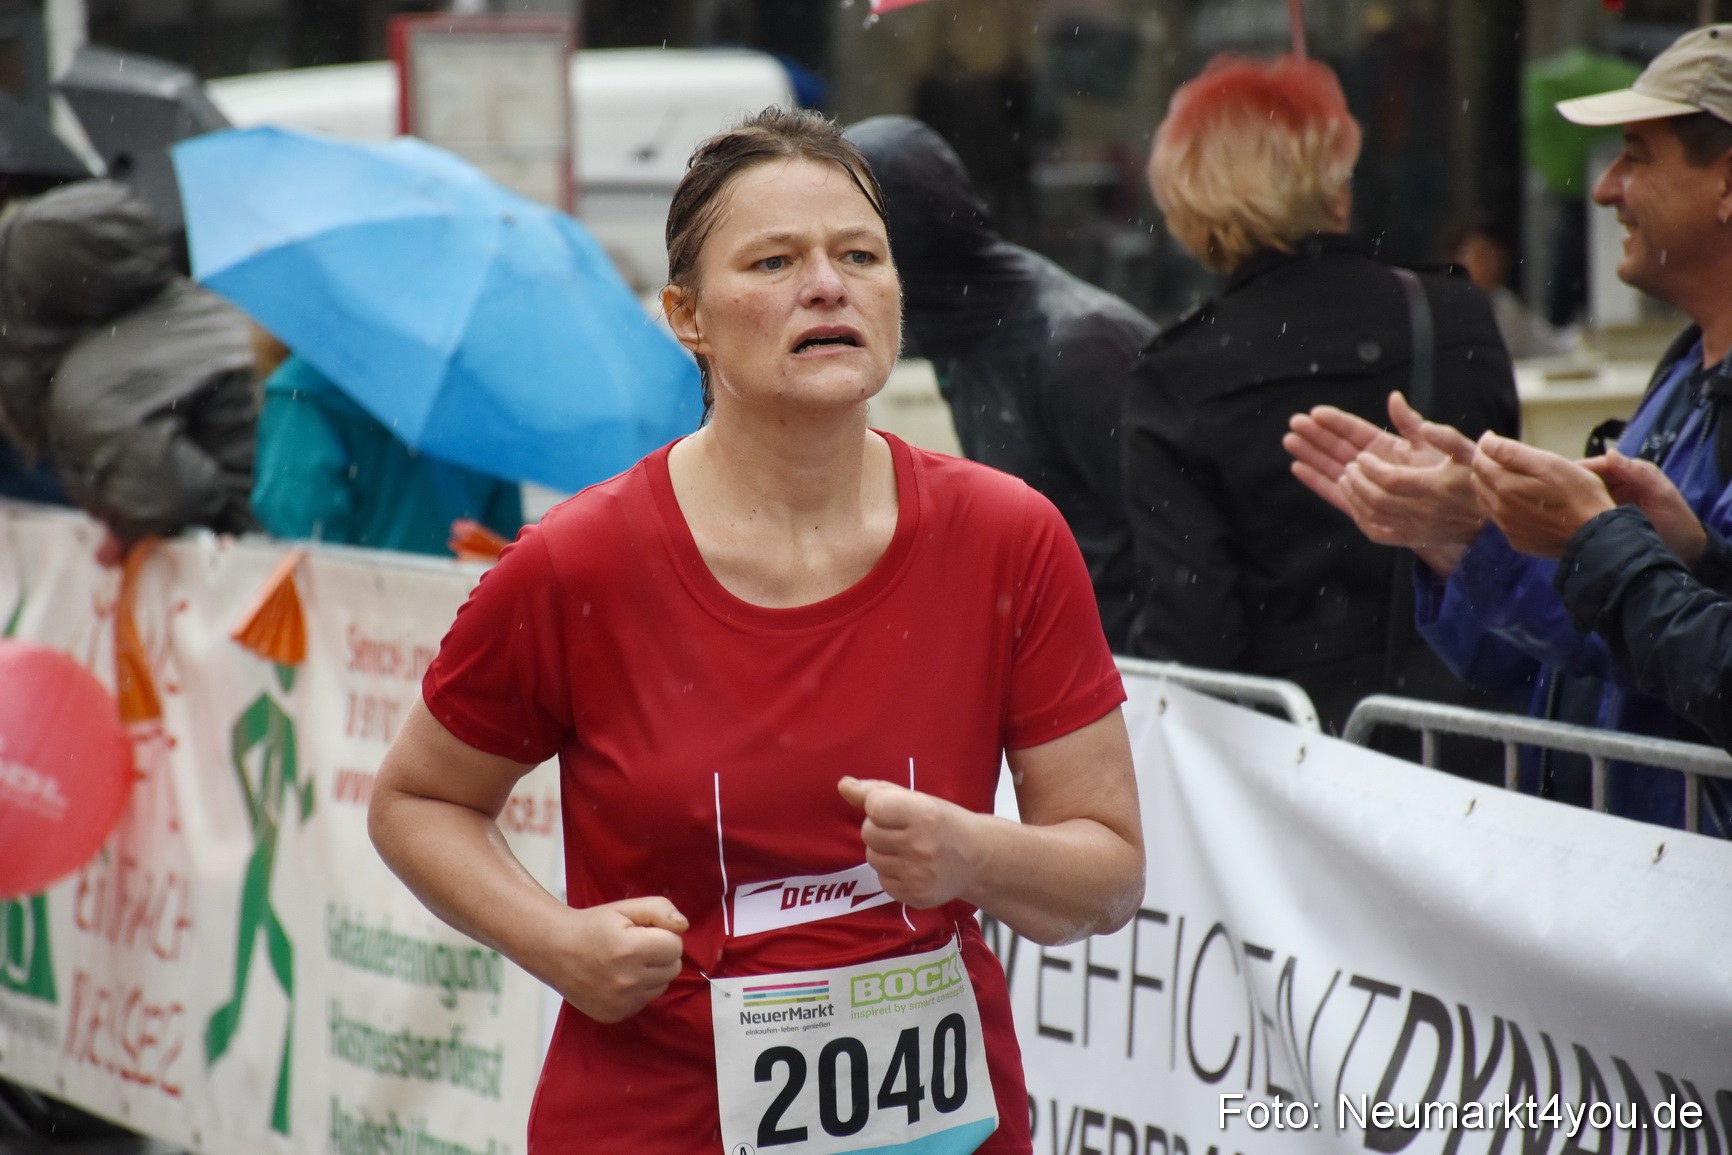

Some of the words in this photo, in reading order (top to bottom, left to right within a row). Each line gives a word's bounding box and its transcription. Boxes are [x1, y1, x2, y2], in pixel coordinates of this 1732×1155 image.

[780, 879, 858, 911] DEHN
[850, 953, 963, 1008] BOCK
[739, 1003, 834, 1025] NeuerMarkt
[851, 1007, 891, 1020] inspired
[894, 1003, 907, 1014] by
[909, 997, 936, 1011] smart
[936, 984, 965, 1004] concepts
[753, 1012, 968, 1149] 2040
